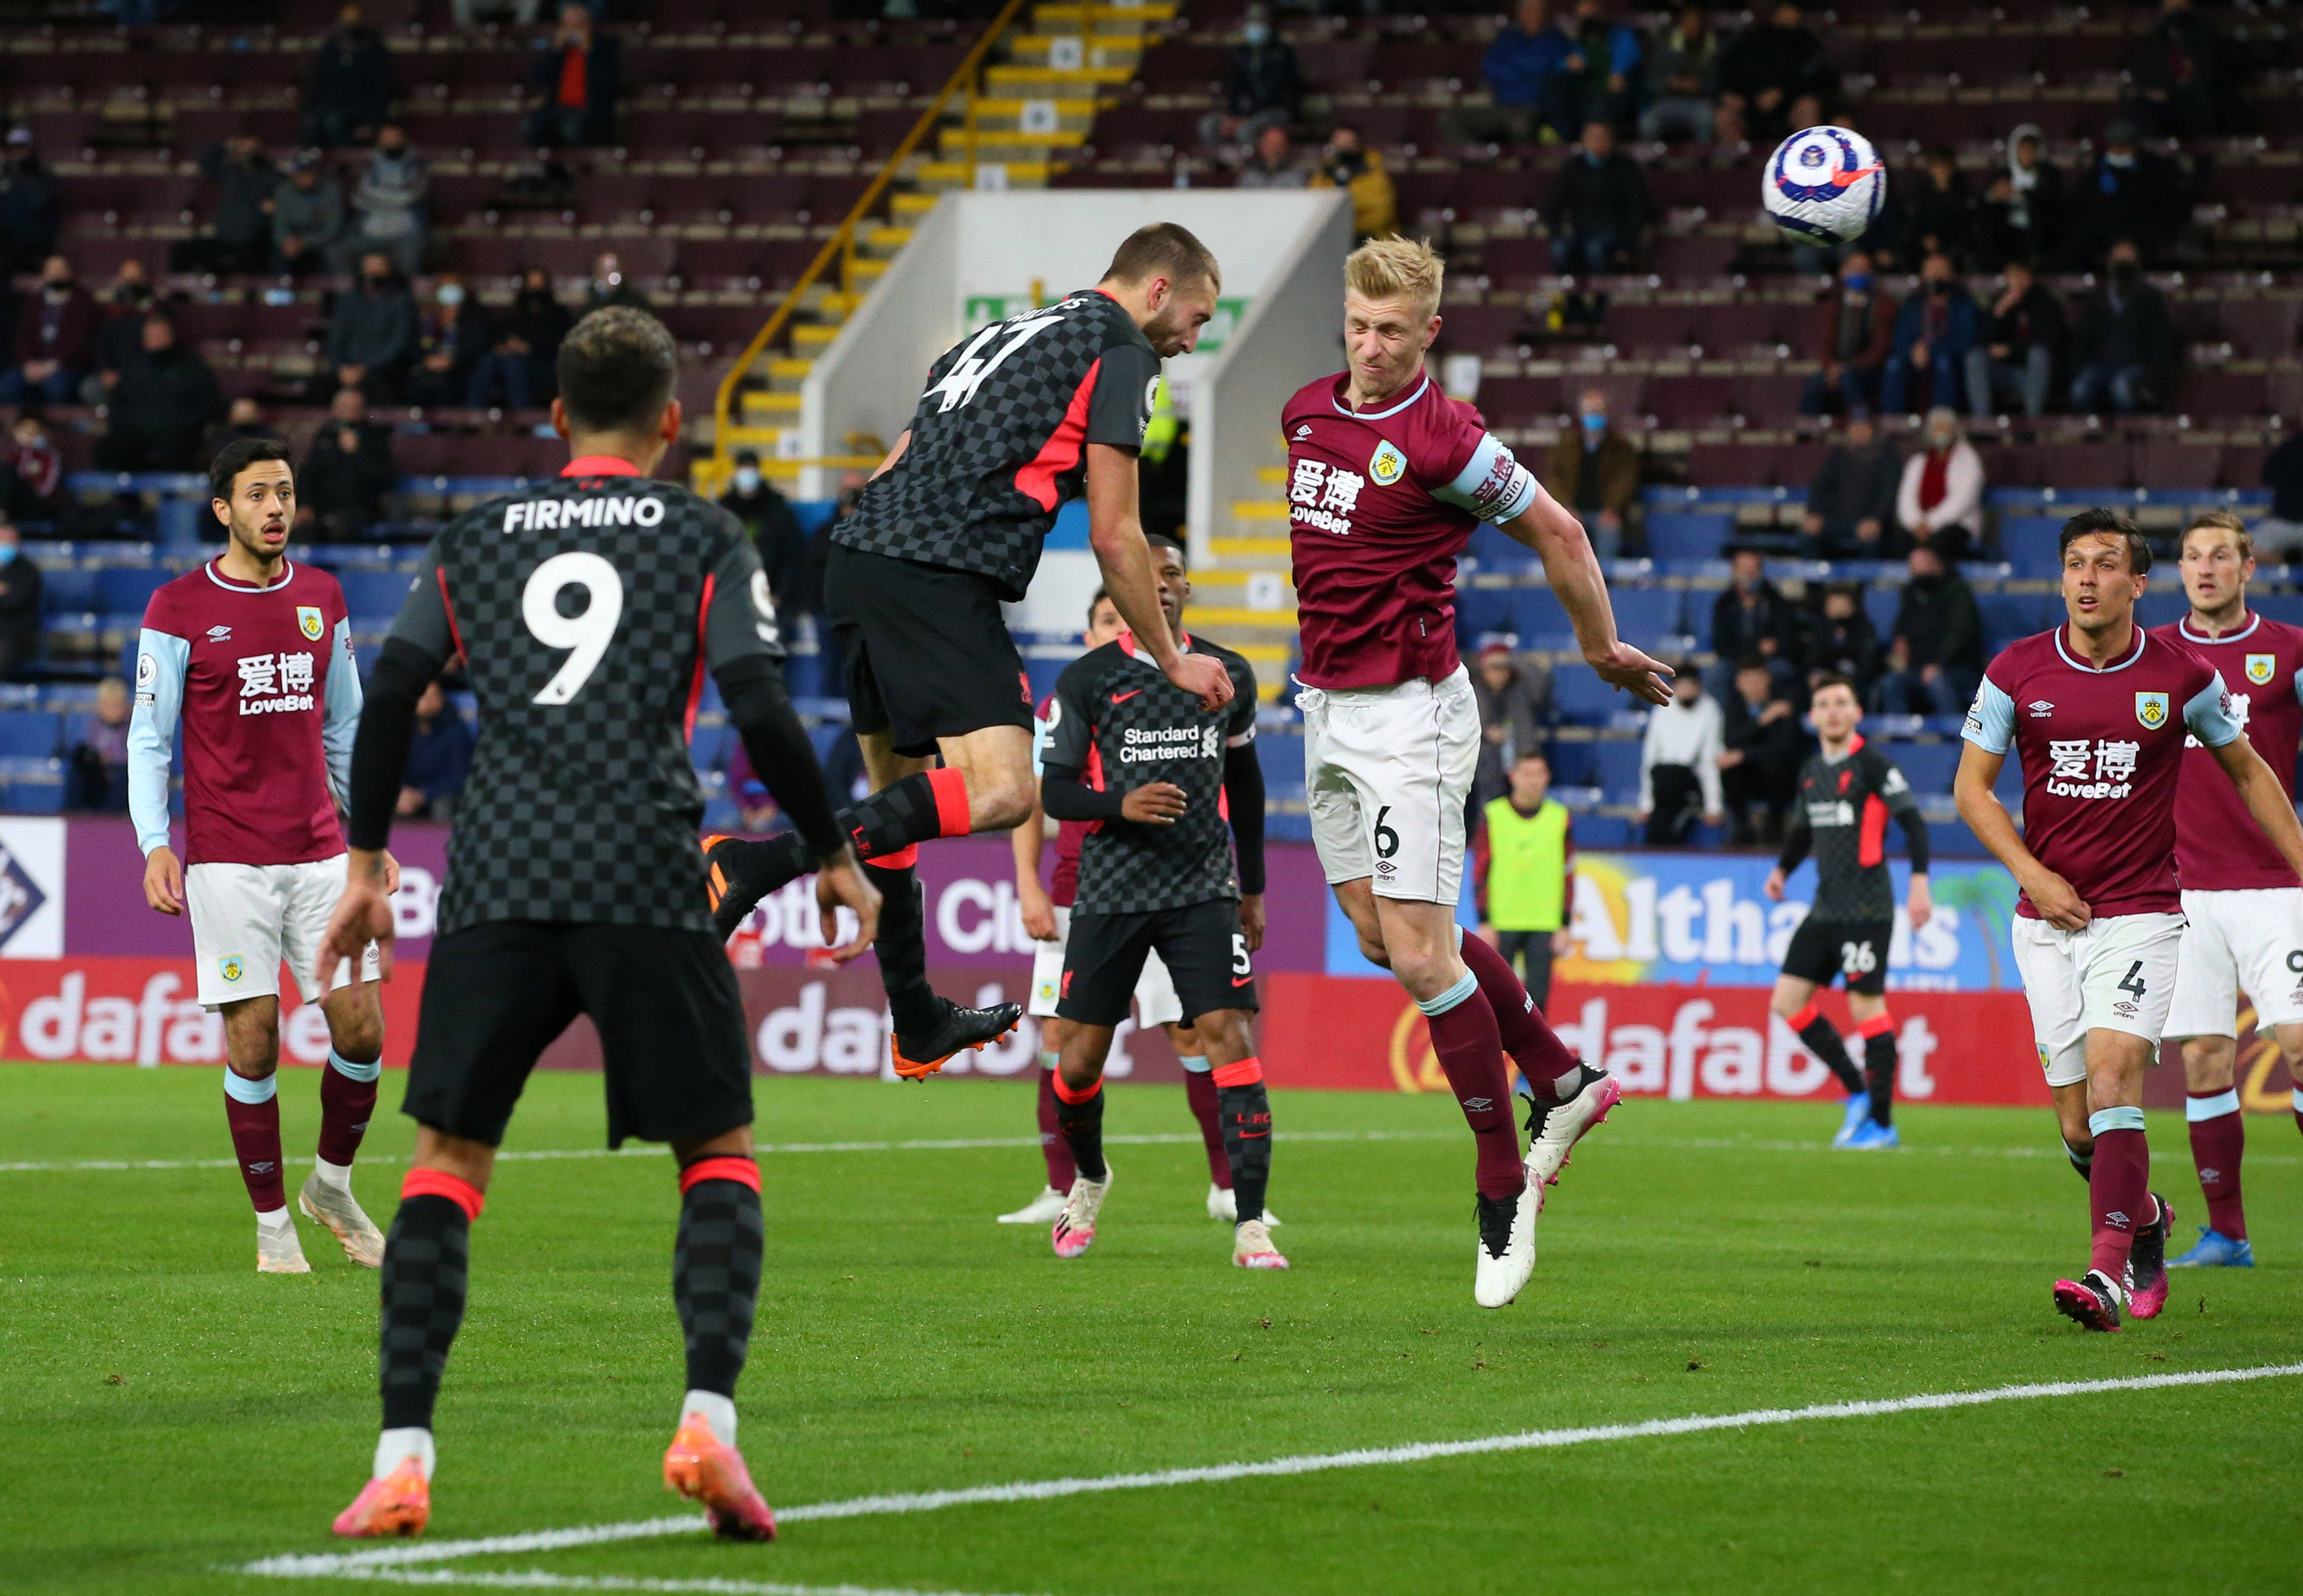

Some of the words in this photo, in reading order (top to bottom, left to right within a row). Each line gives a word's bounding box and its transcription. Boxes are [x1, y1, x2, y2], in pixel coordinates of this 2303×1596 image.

[921, 315, 1066, 414] 47
[1290, 459, 1365, 517] 爱博
[1476, 480, 1521, 517] Captain
[502, 496, 666, 533] FIRMINO
[522, 551, 623, 704] 9
[237, 651, 314, 697] 爱博
[239, 694, 314, 716] LoveBet
[1119, 743, 1198, 763] Chartered
[1124, 724, 1199, 745] Standard
[2049, 739, 2140, 781] 爱博
[2046, 777, 2132, 799] LoveBet
[1374, 805, 1399, 859] 6
[1570, 874, 1960, 969] Althas
[1231, 933, 1251, 975] 5
[1841, 940, 1877, 973] 26
[2118, 960, 2147, 1004] 4
[20, 971, 332, 1067] dafae
[2113, 1011, 2135, 1020] umbro
[2105, 1221, 2127, 1229] umbro
